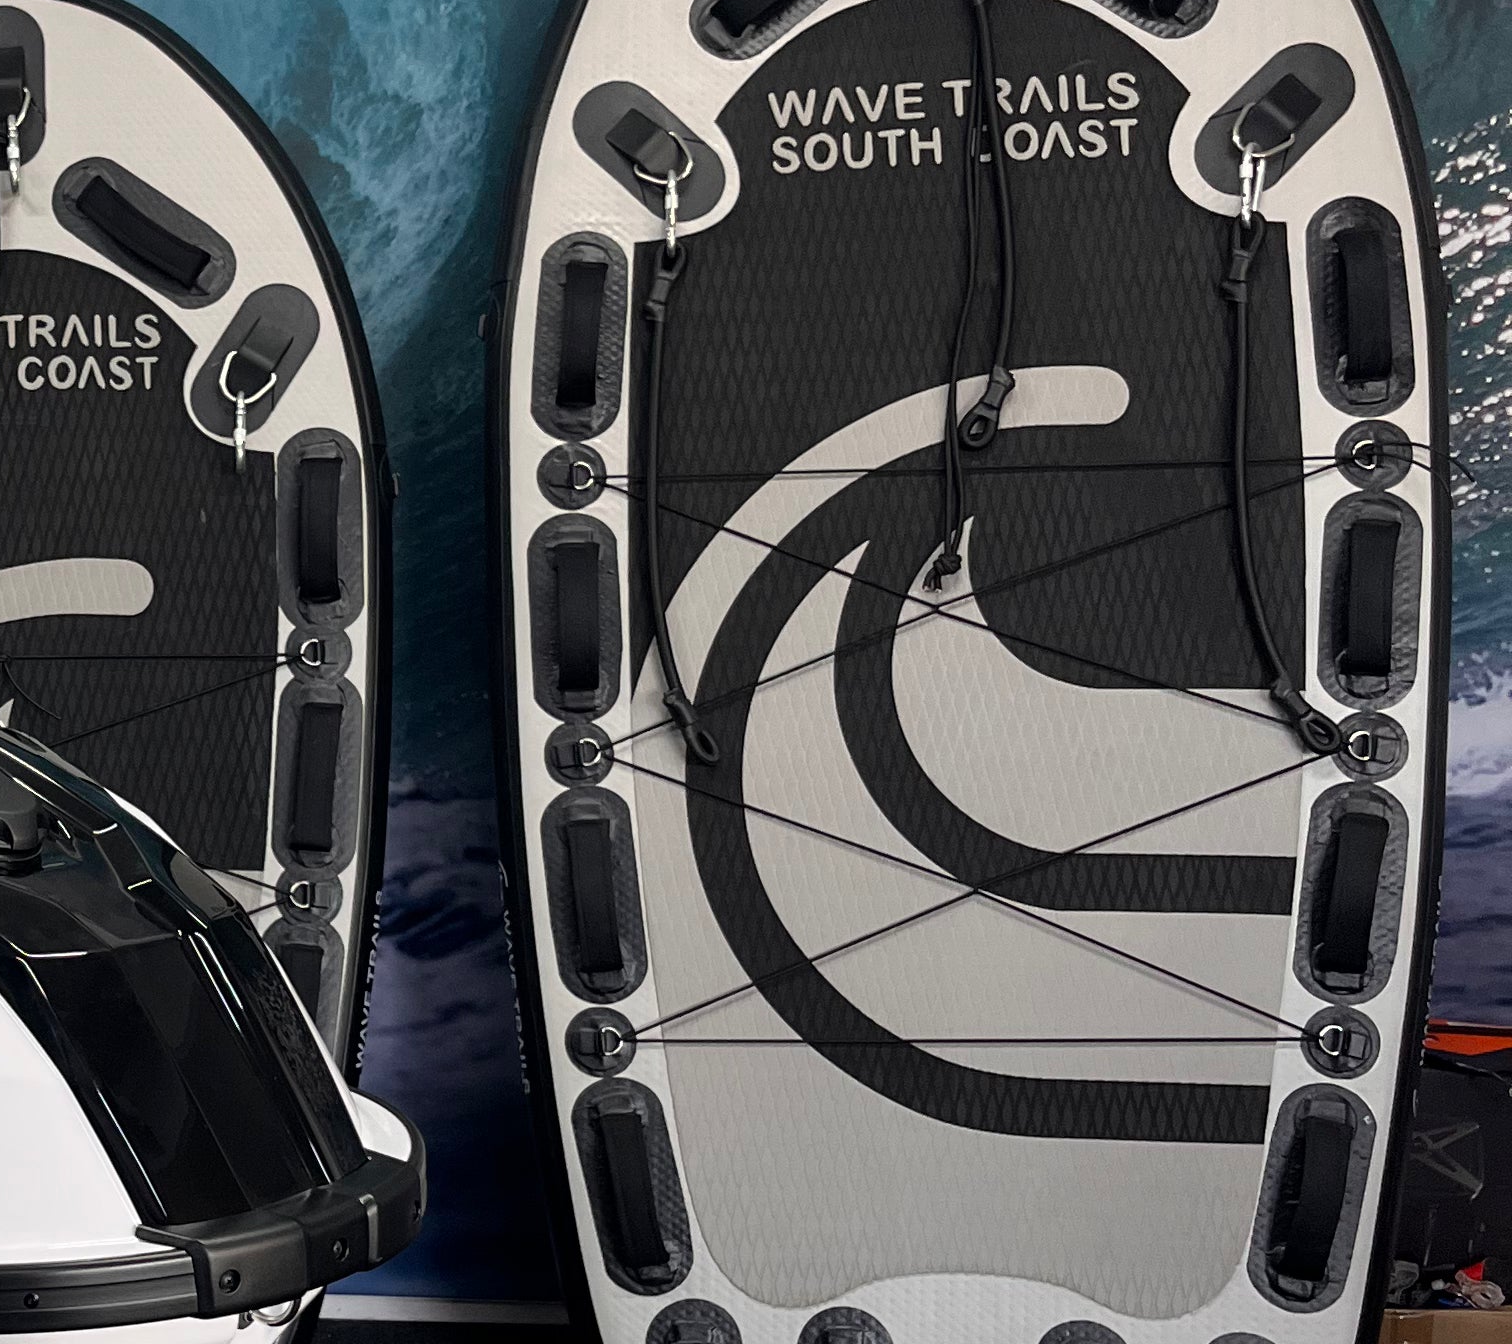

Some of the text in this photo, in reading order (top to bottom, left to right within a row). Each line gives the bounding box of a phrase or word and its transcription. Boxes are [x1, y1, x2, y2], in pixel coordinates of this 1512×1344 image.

[767, 72, 1141, 129] WAVE TRAILS
[772, 118, 1139, 175] SOUTH OAST
[17, 356, 159, 392] COAST
